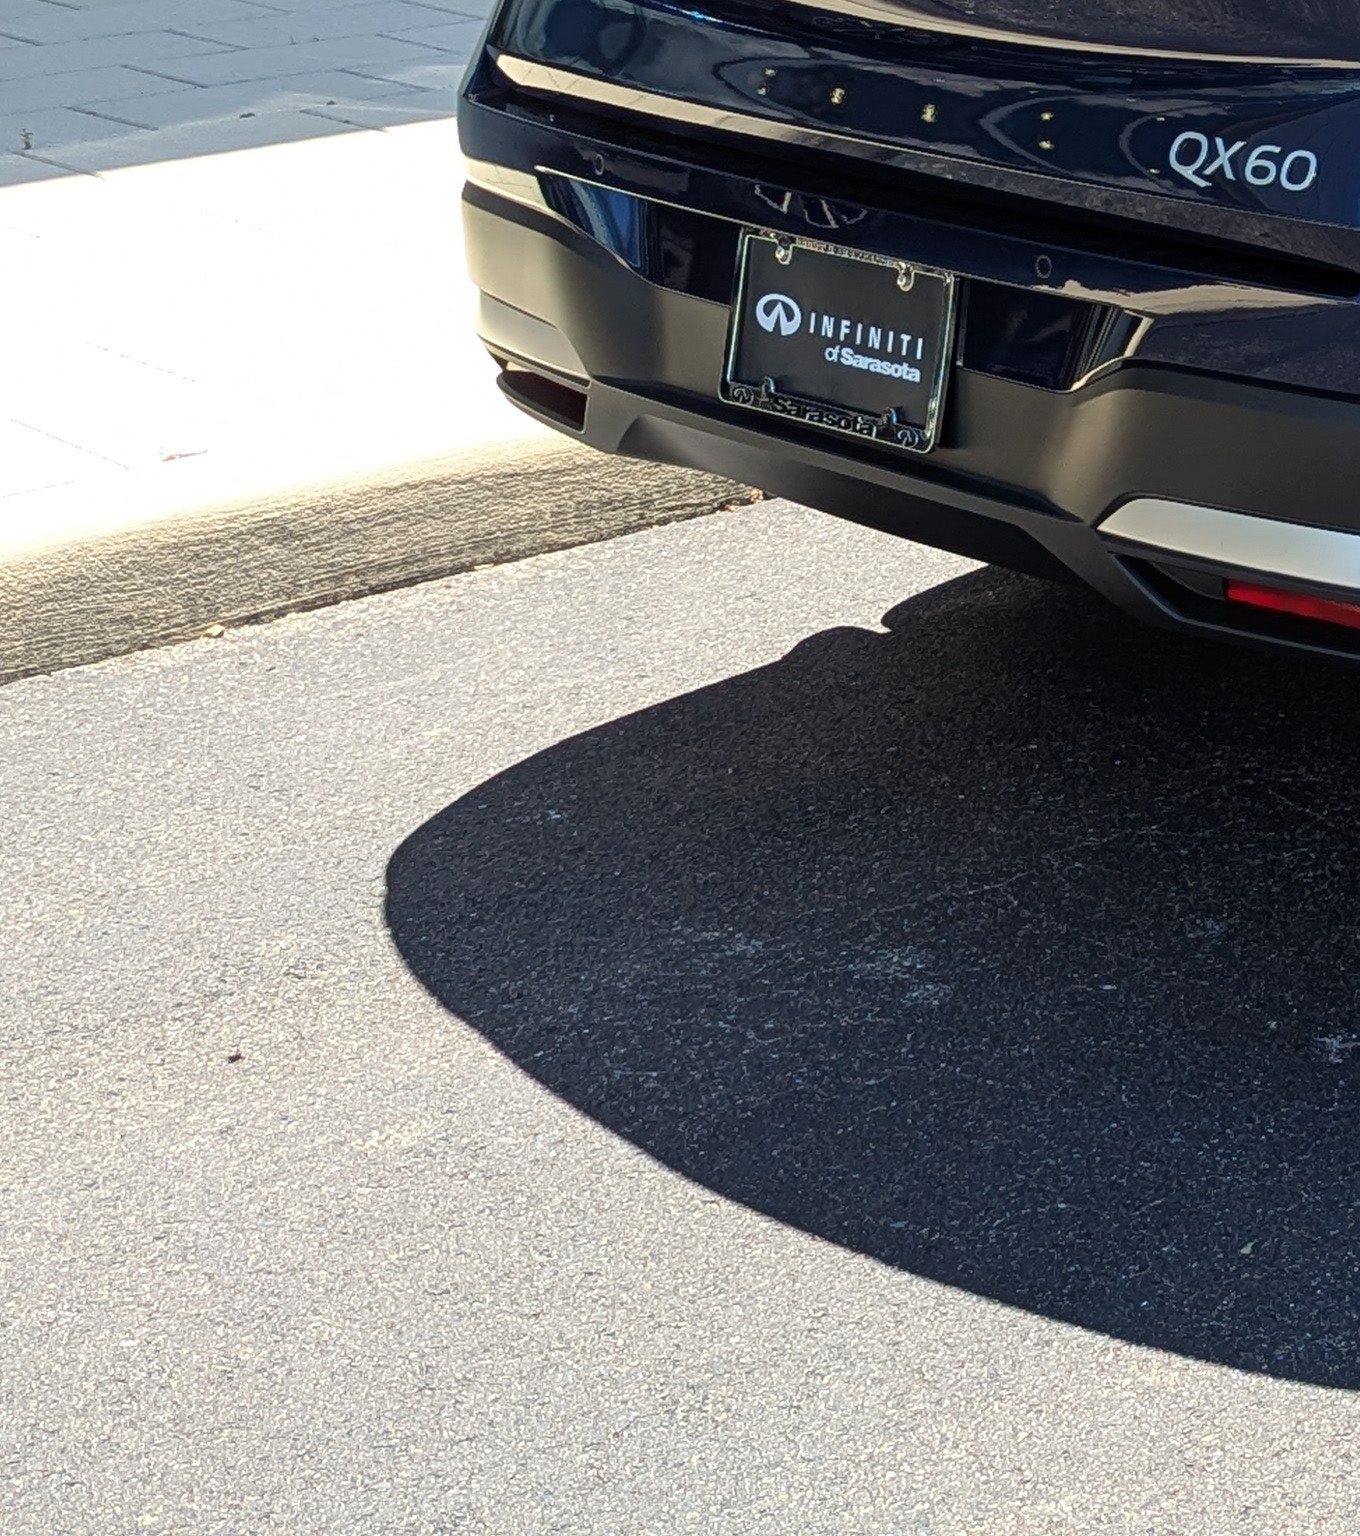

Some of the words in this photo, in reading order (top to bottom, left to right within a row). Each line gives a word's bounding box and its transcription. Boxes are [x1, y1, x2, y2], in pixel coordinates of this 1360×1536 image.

[1169, 130, 1318, 192] QX60
[808, 312, 924, 360] INFINITI
[825, 344, 840, 363] of
[839, 346, 921, 383] Sarasota
